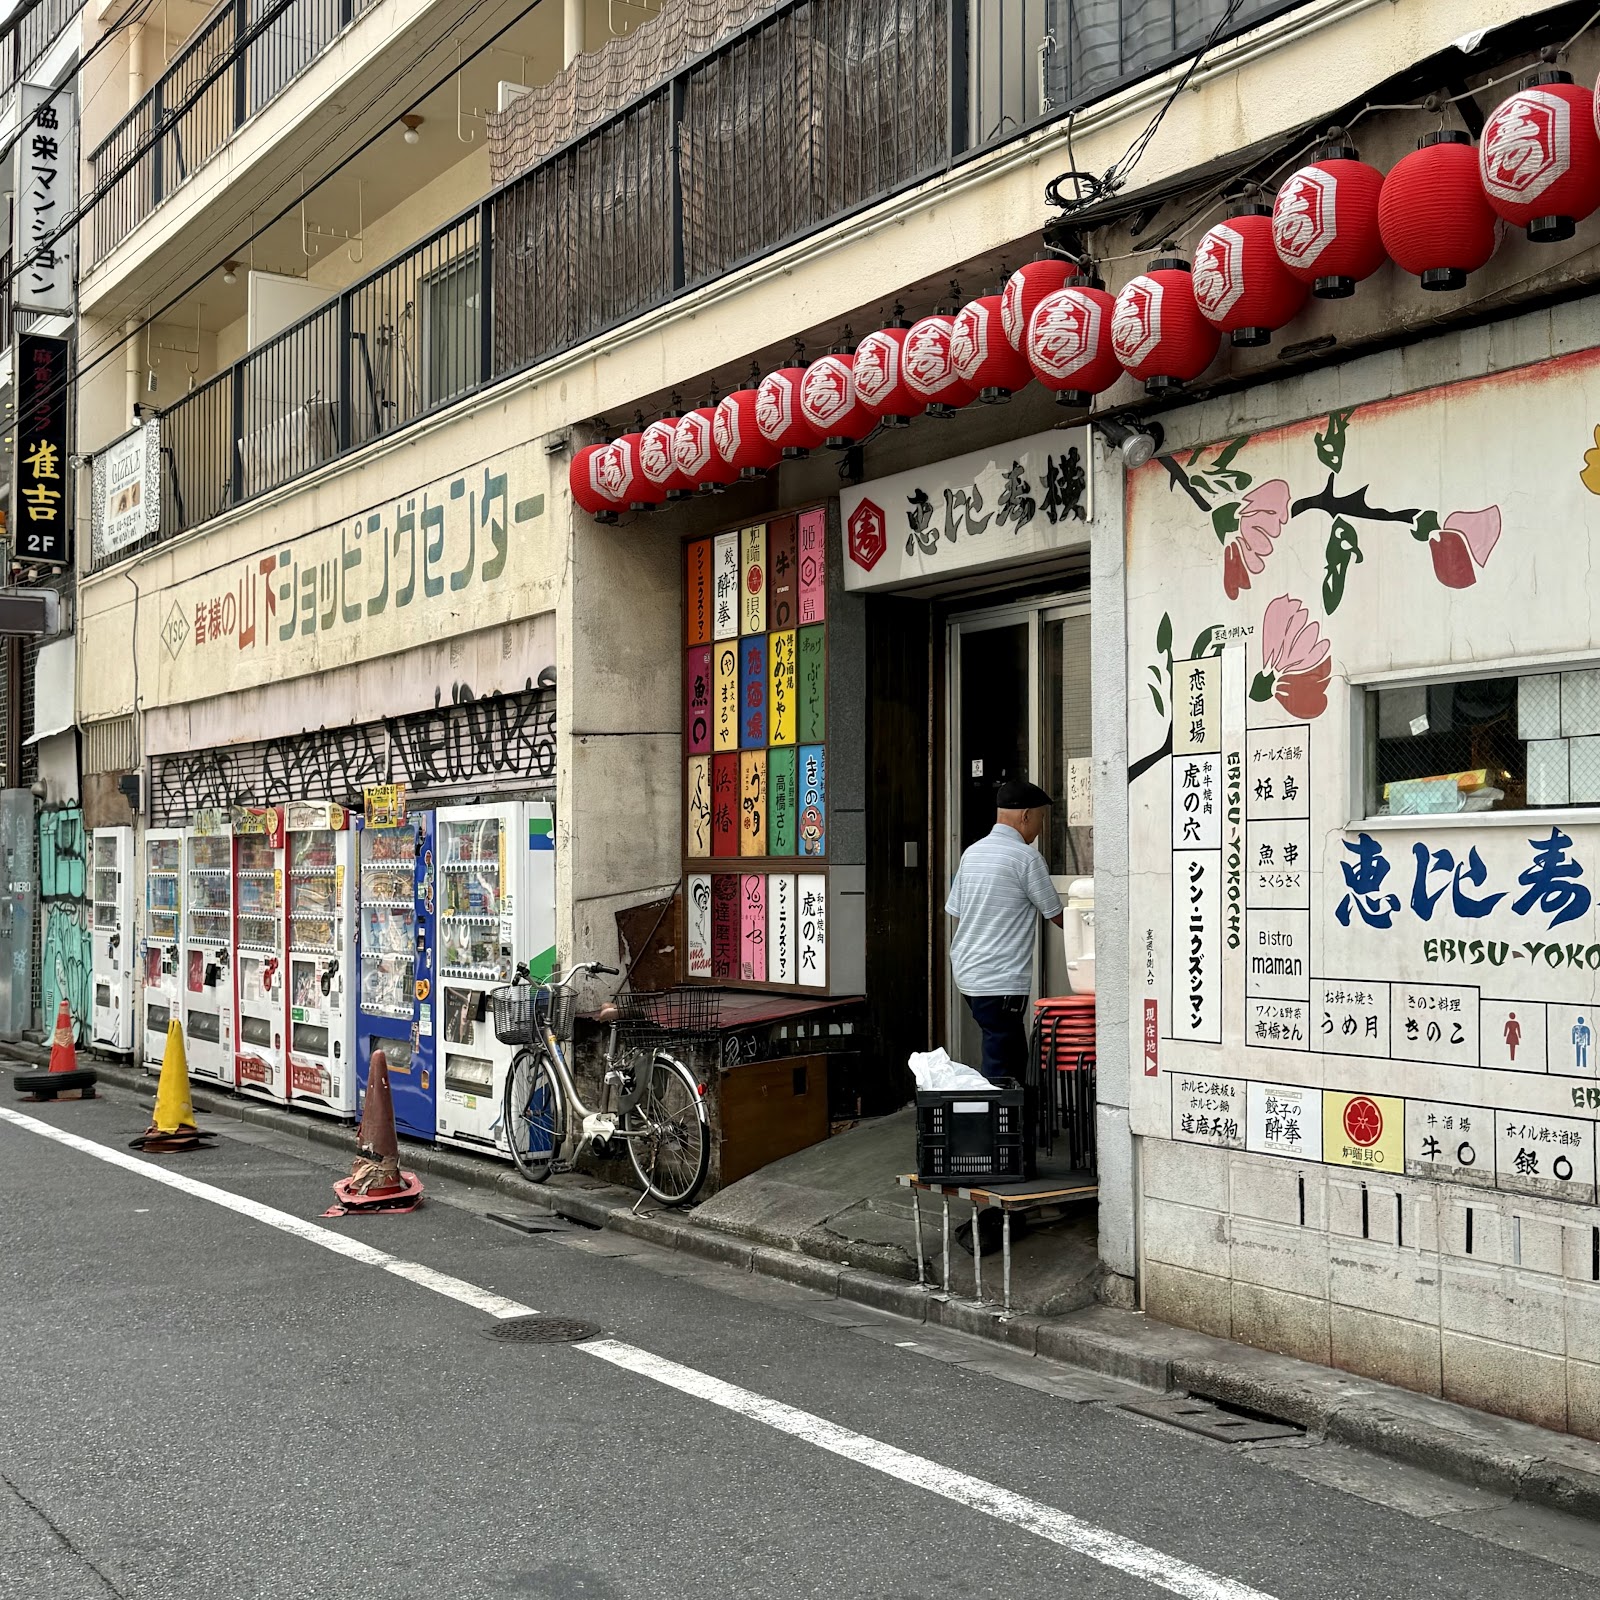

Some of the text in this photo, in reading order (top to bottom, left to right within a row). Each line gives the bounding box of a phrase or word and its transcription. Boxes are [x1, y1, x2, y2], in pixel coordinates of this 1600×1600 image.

[31, 104, 59, 294] 協栄マンション
[21, 439, 62, 522] 雀吉
[27, 535, 55, 552] 2F
[717, 571, 731, 628] 酔拳
[167, 620, 185, 646] YSC
[719, 683, 730, 743] まるや
[1188, 668, 1206, 744] 恋酒場
[1253, 746, 1303, 763] ガールズ酒場
[805, 754, 819, 837] きのこ
[1182, 762, 1202, 842] 虎の穴
[1202, 761, 1213, 815] 和牛焼肉
[1254, 774, 1300, 802] 姫島
[1258, 874, 1301, 889] さくらさく
[1335, 826, 1592, 931] 恵比寿
[801, 890, 817, 970] 虎の穴
[1258, 931, 1293, 947] Bistro
[1252, 956, 1303, 977] maman
[1324, 989, 1375, 1006] お好み焼き
[1407, 994, 1462, 1012] きのこ料理
[1145, 1006, 1157, 1054] 現在地
[1320, 1011, 1379, 1040] うめ月
[1404, 1016, 1466, 1045] きのこ
[1190, 1096, 1230, 1113] ホルモン鍋
[1265, 1096, 1301, 1121] 餃子の
[1181, 1112, 1238, 1140] 達磨天狗
[1265, 1117, 1303, 1145] 酔拳
[1426, 1112, 1472, 1133] 牛酒場
[1505, 1122, 1583, 1147] ホイル焼き酒場
